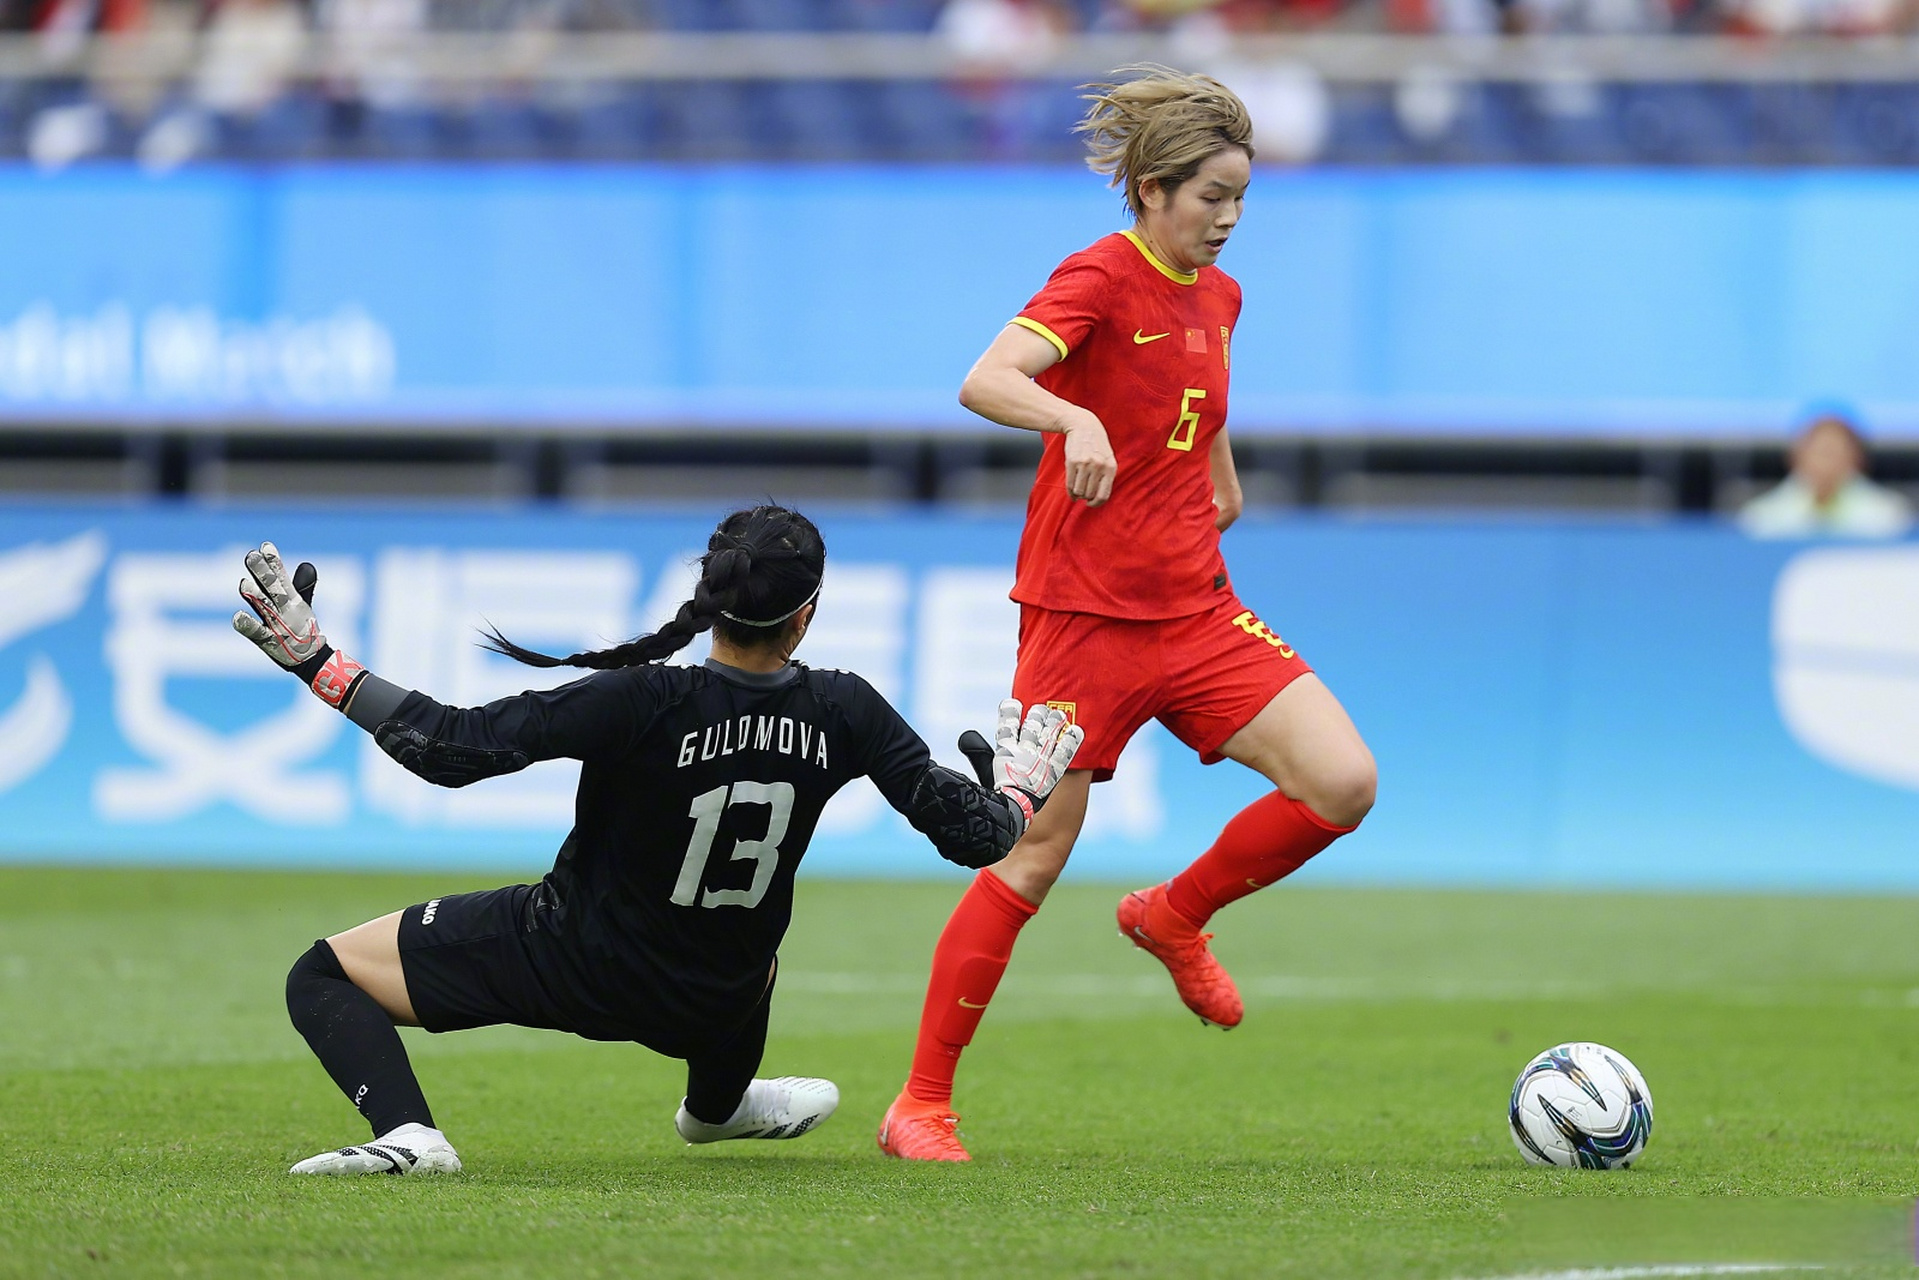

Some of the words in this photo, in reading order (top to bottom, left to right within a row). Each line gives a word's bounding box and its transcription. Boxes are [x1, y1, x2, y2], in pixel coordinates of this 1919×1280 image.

[1167, 388, 1206, 451] 6
[312, 649, 365, 704] GK
[677, 715, 828, 770] GULOMOVA
[669, 781, 795, 909] 13
